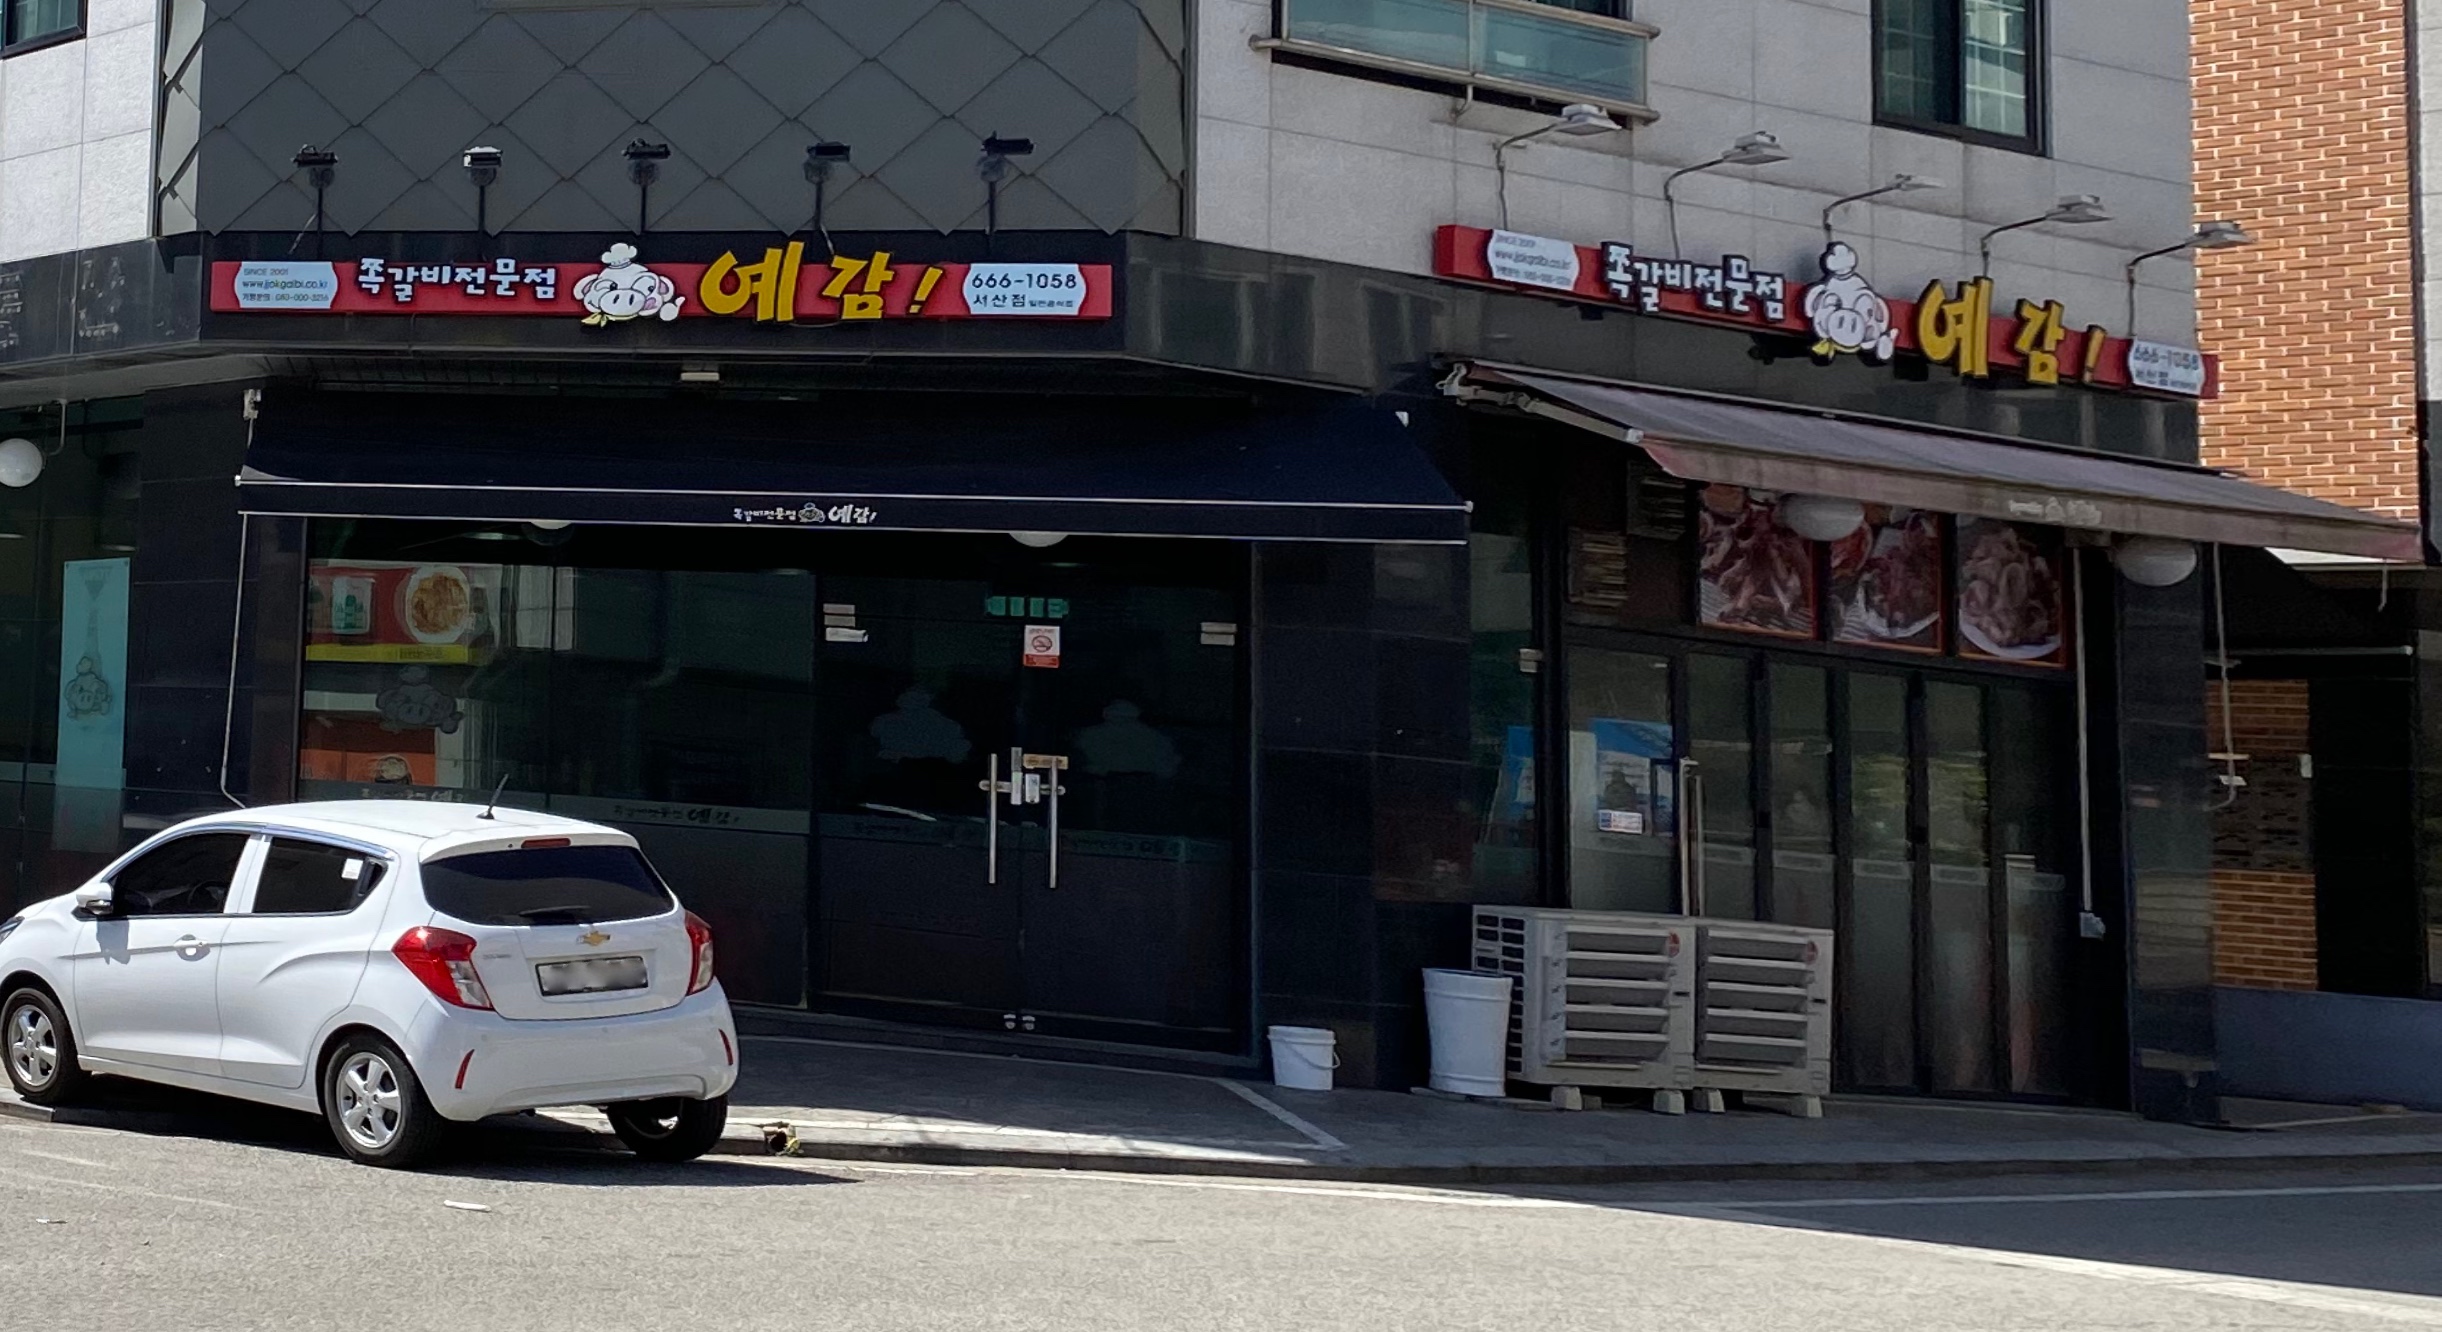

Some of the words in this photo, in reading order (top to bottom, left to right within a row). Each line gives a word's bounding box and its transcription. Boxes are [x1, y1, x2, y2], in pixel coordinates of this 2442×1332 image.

[358, 257, 556, 302] 쪽갈비전문점
[972, 272, 1077, 289] 666-1058
[1605, 244, 1784, 320] 쪽갈비전문점
